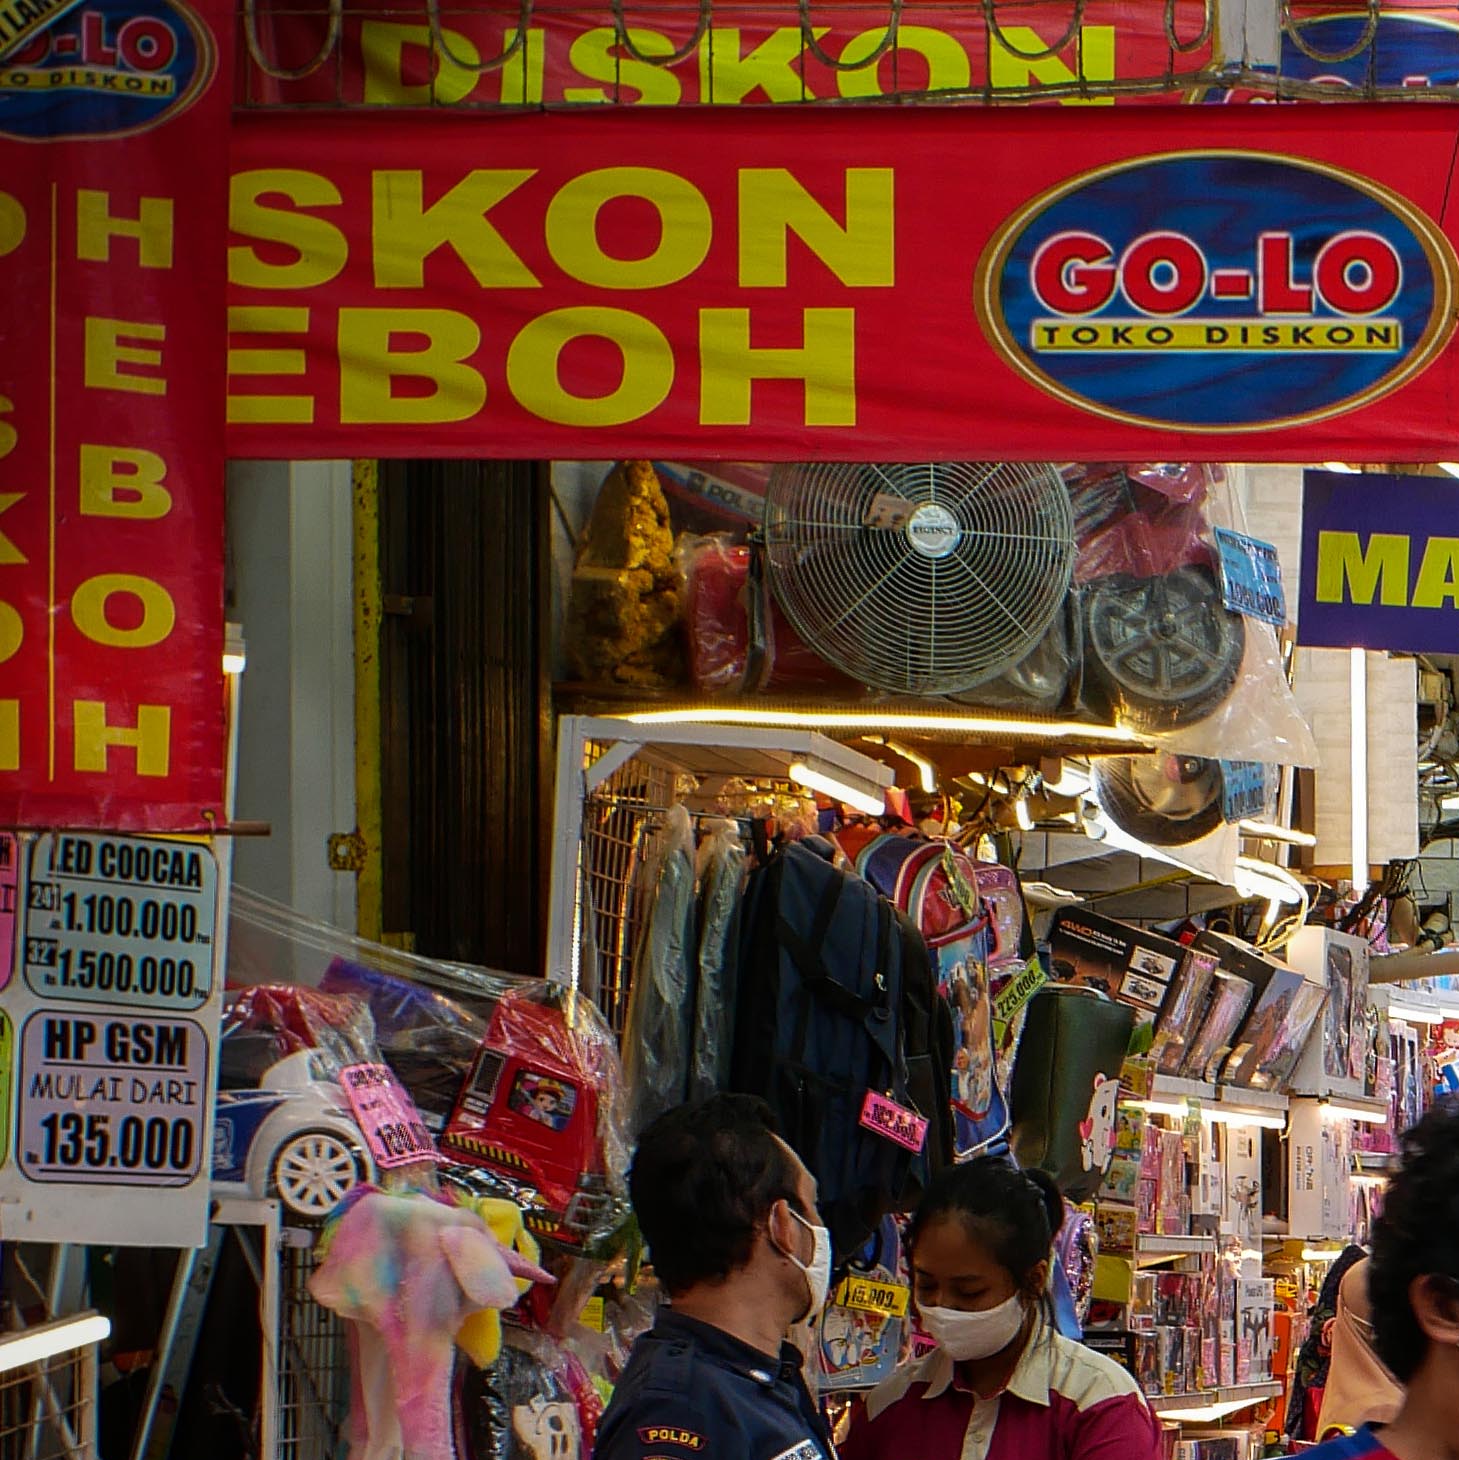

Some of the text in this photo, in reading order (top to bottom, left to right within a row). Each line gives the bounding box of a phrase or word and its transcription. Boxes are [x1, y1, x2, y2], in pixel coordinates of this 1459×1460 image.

[50, 71, 168, 92] DISKON
[360, 20, 1116, 106] DISKON
[227, 167, 893, 290] SKON
[1030, 230, 1402, 316] GO-LO
[1042, 324, 1396, 347] TOKO DISKON
[226, 305, 857, 427] EBOH
[71, 188, 176, 778] HEBOH
[100, 841, 203, 888] COOCAA
[62, 890, 198, 944] 1.100.000
[58, 946, 195, 998] 1.500.000
[44, 1018, 188, 1066] HP GSM
[29, 1071, 198, 1106] MULAI DARI
[39, 1111, 194, 1170] 135.000
[648, 1429, 700, 1448] POLDA
